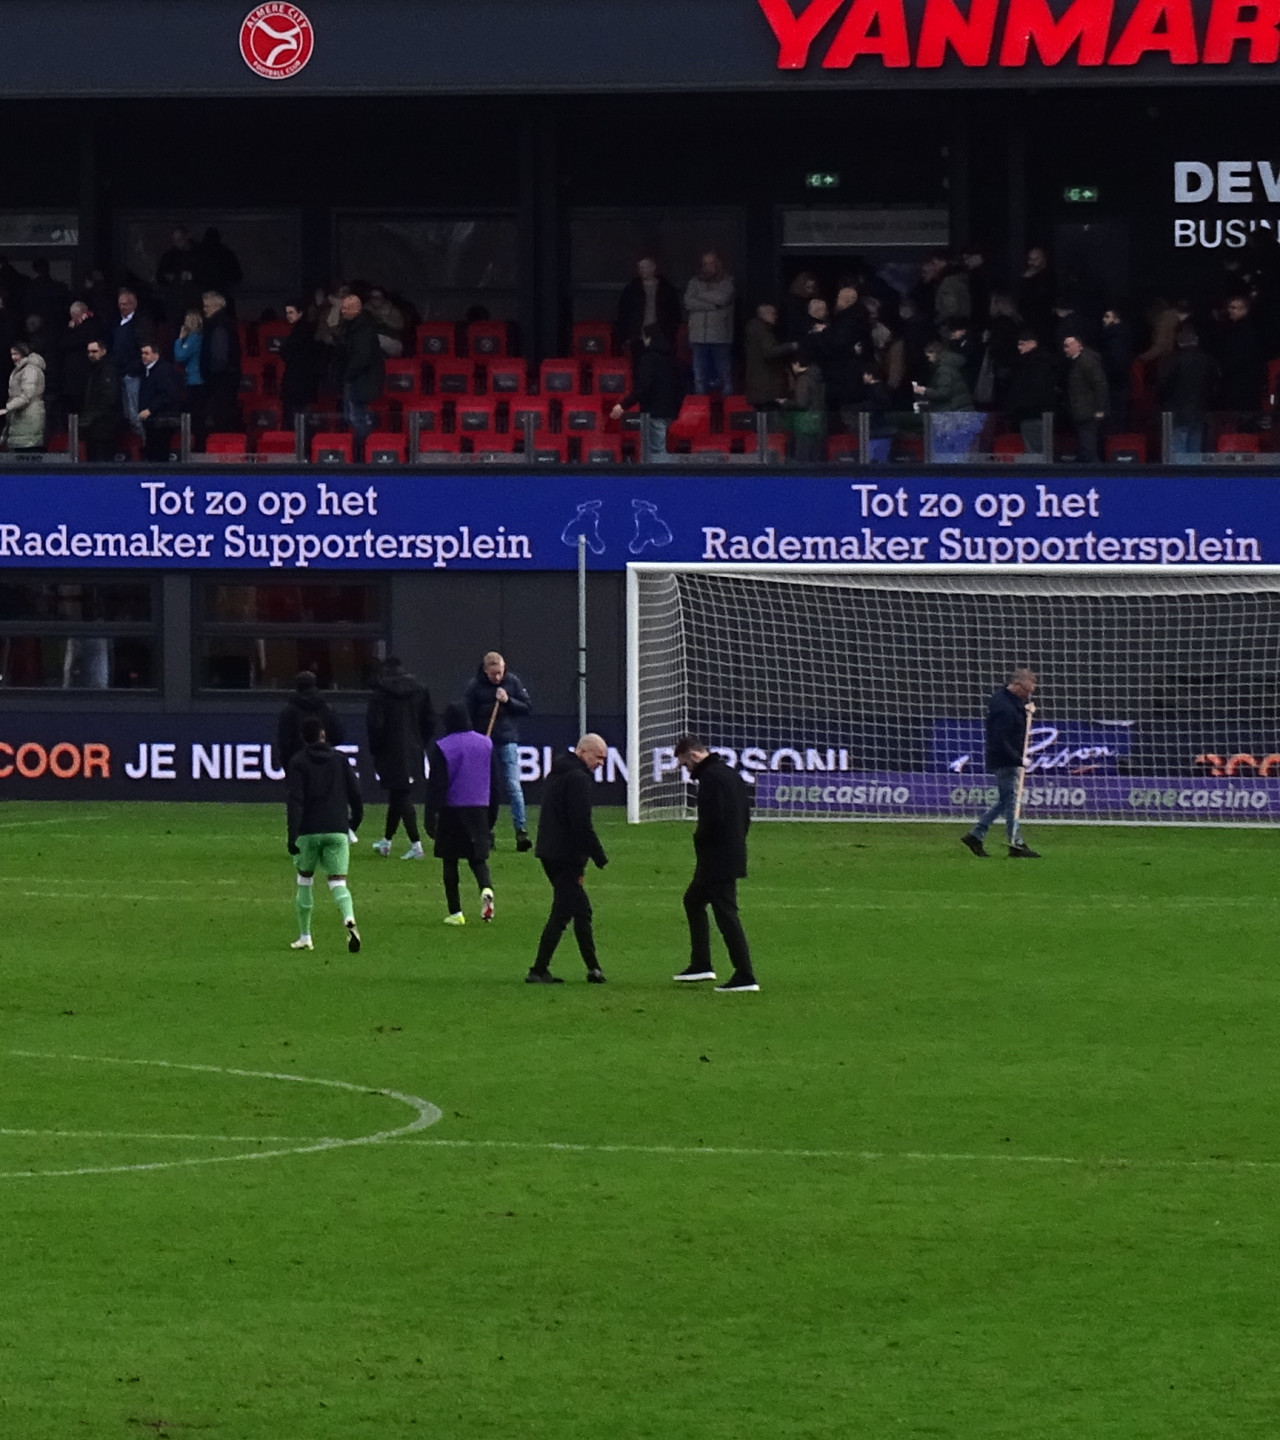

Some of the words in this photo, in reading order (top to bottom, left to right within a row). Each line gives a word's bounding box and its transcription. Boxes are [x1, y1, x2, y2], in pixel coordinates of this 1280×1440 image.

[246, 4, 286, 29] ALMERE
[287, 8, 308, 29] CITY
[141, 482, 195, 515] Tot
[206, 491, 247, 515] zo
[259, 491, 307, 524] op
[317, 482, 378, 516] het
[852, 484, 909, 518] Tot
[919, 493, 963, 518] zo
[975, 493, 1025, 527] op
[1035, 484, 1099, 518] het
[224, 521, 532, 567] Supportersplein
[702, 526, 929, 561] Rademaker
[939, 526, 1262, 564] Supportersplein
[125, 743, 177, 780] JE
[775, 780, 910, 805] onecasino
[951, 780, 1087, 807] oneasino
